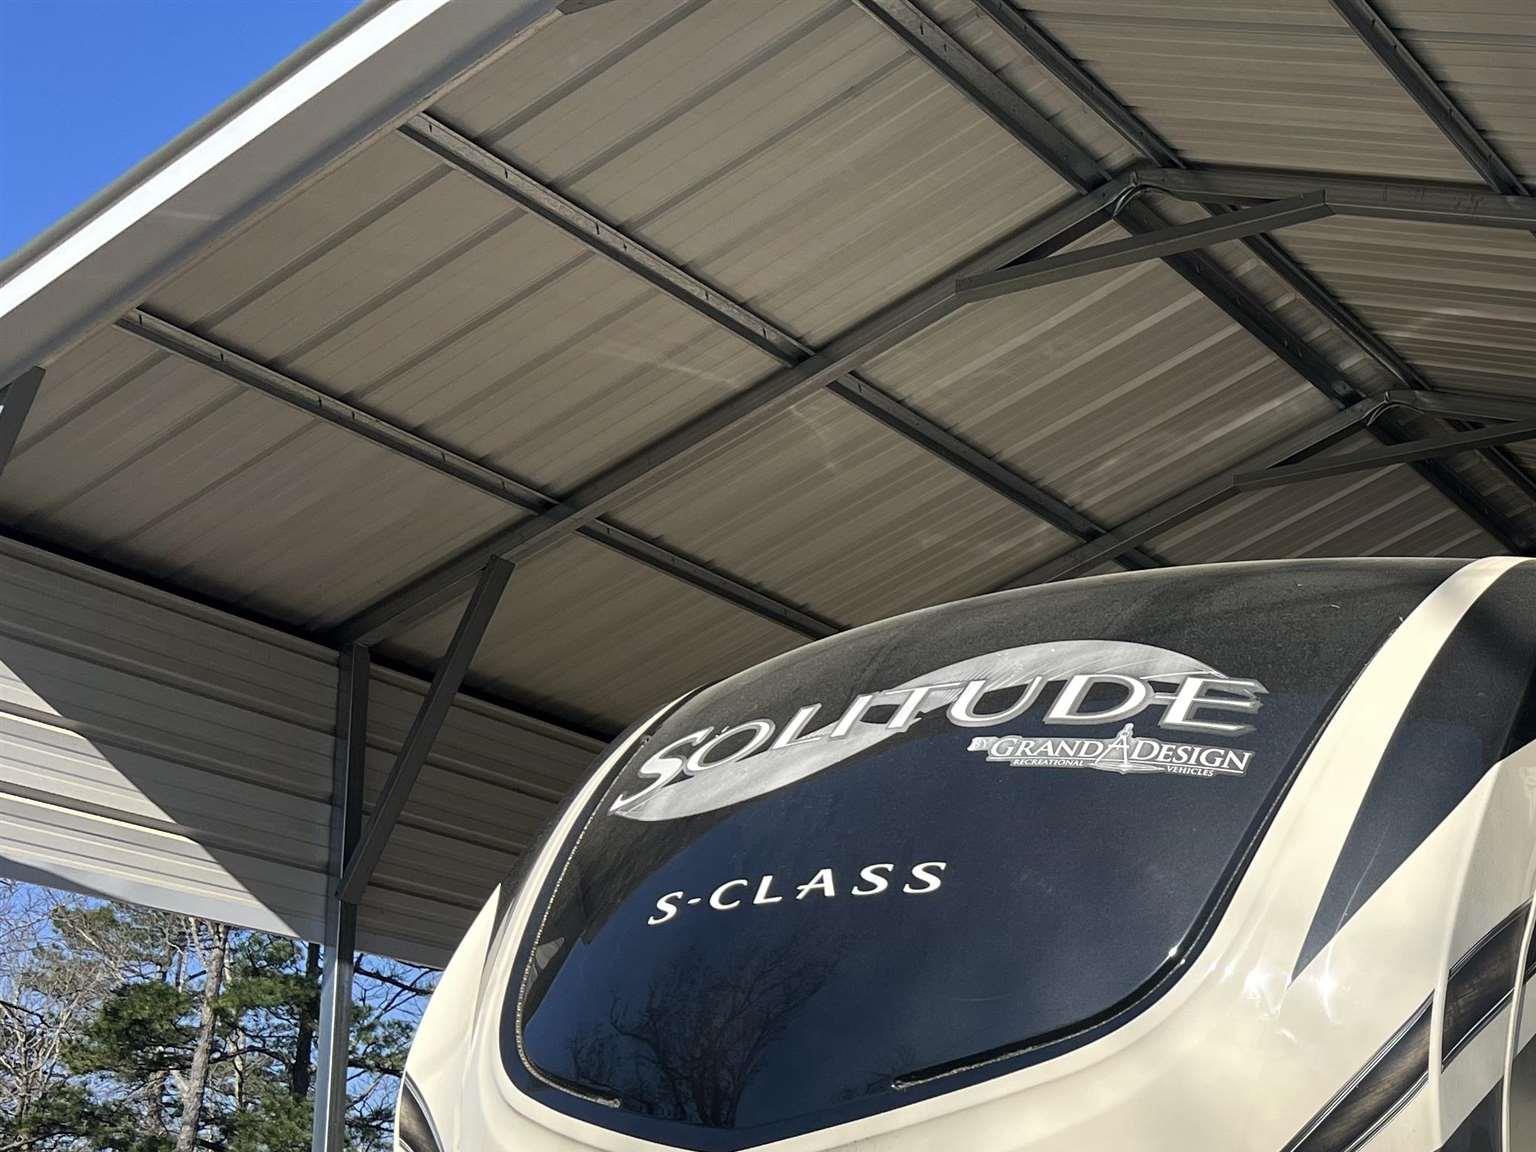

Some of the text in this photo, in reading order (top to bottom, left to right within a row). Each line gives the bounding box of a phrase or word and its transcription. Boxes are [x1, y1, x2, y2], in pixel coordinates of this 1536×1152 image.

[609, 673, 1268, 815] SOLITUDE
[990, 738, 1104, 757] GRAND
[1129, 740, 1252, 771] DESIGN
[1012, 758, 1215, 777] RECREATIONAL VEHICLES
[647, 861, 947, 925] S-CLASS
